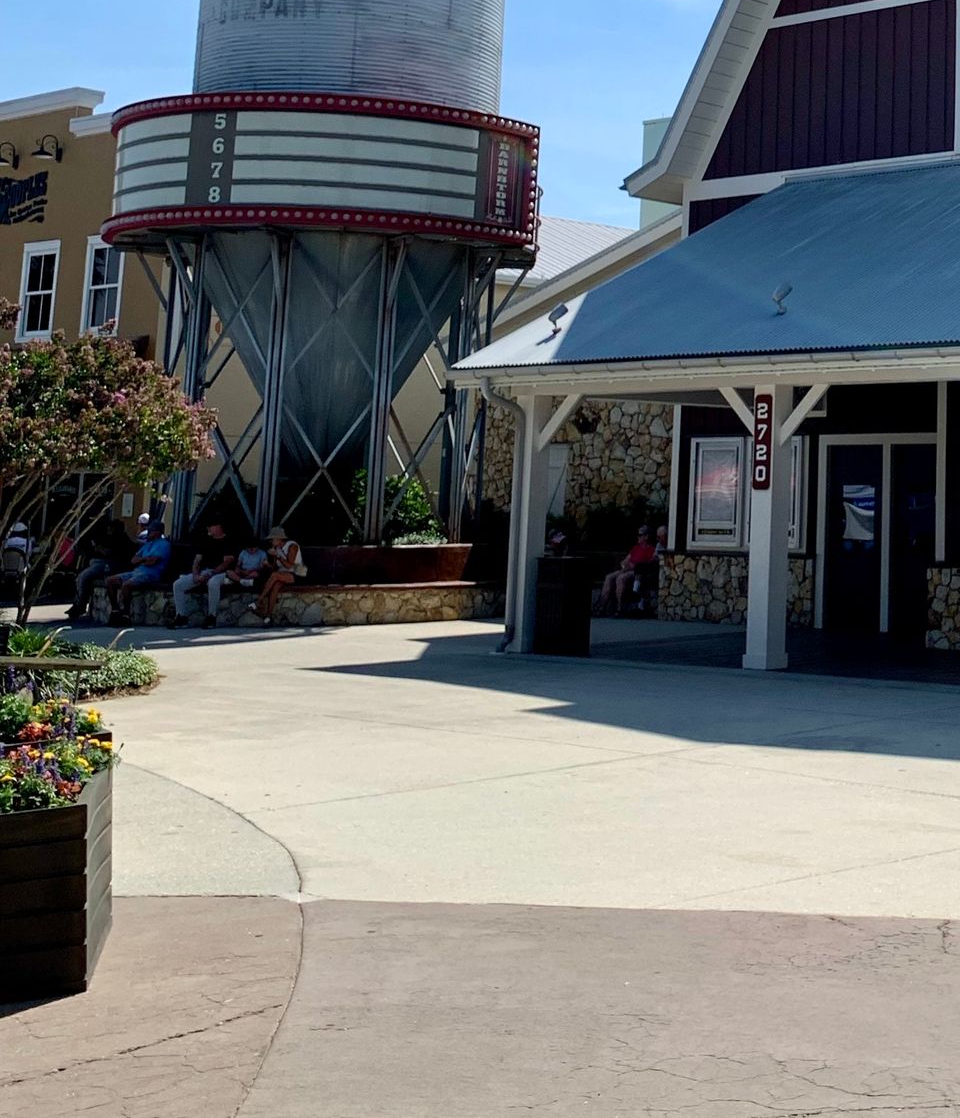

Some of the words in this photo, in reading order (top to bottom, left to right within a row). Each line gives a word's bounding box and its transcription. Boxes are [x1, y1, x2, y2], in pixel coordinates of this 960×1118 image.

[214, 113, 226, 130] 5
[212, 137, 224, 154] 6
[211, 162, 223, 178] 7
[208, 186, 220, 203] 8
[755, 402, 768, 482] 2720
